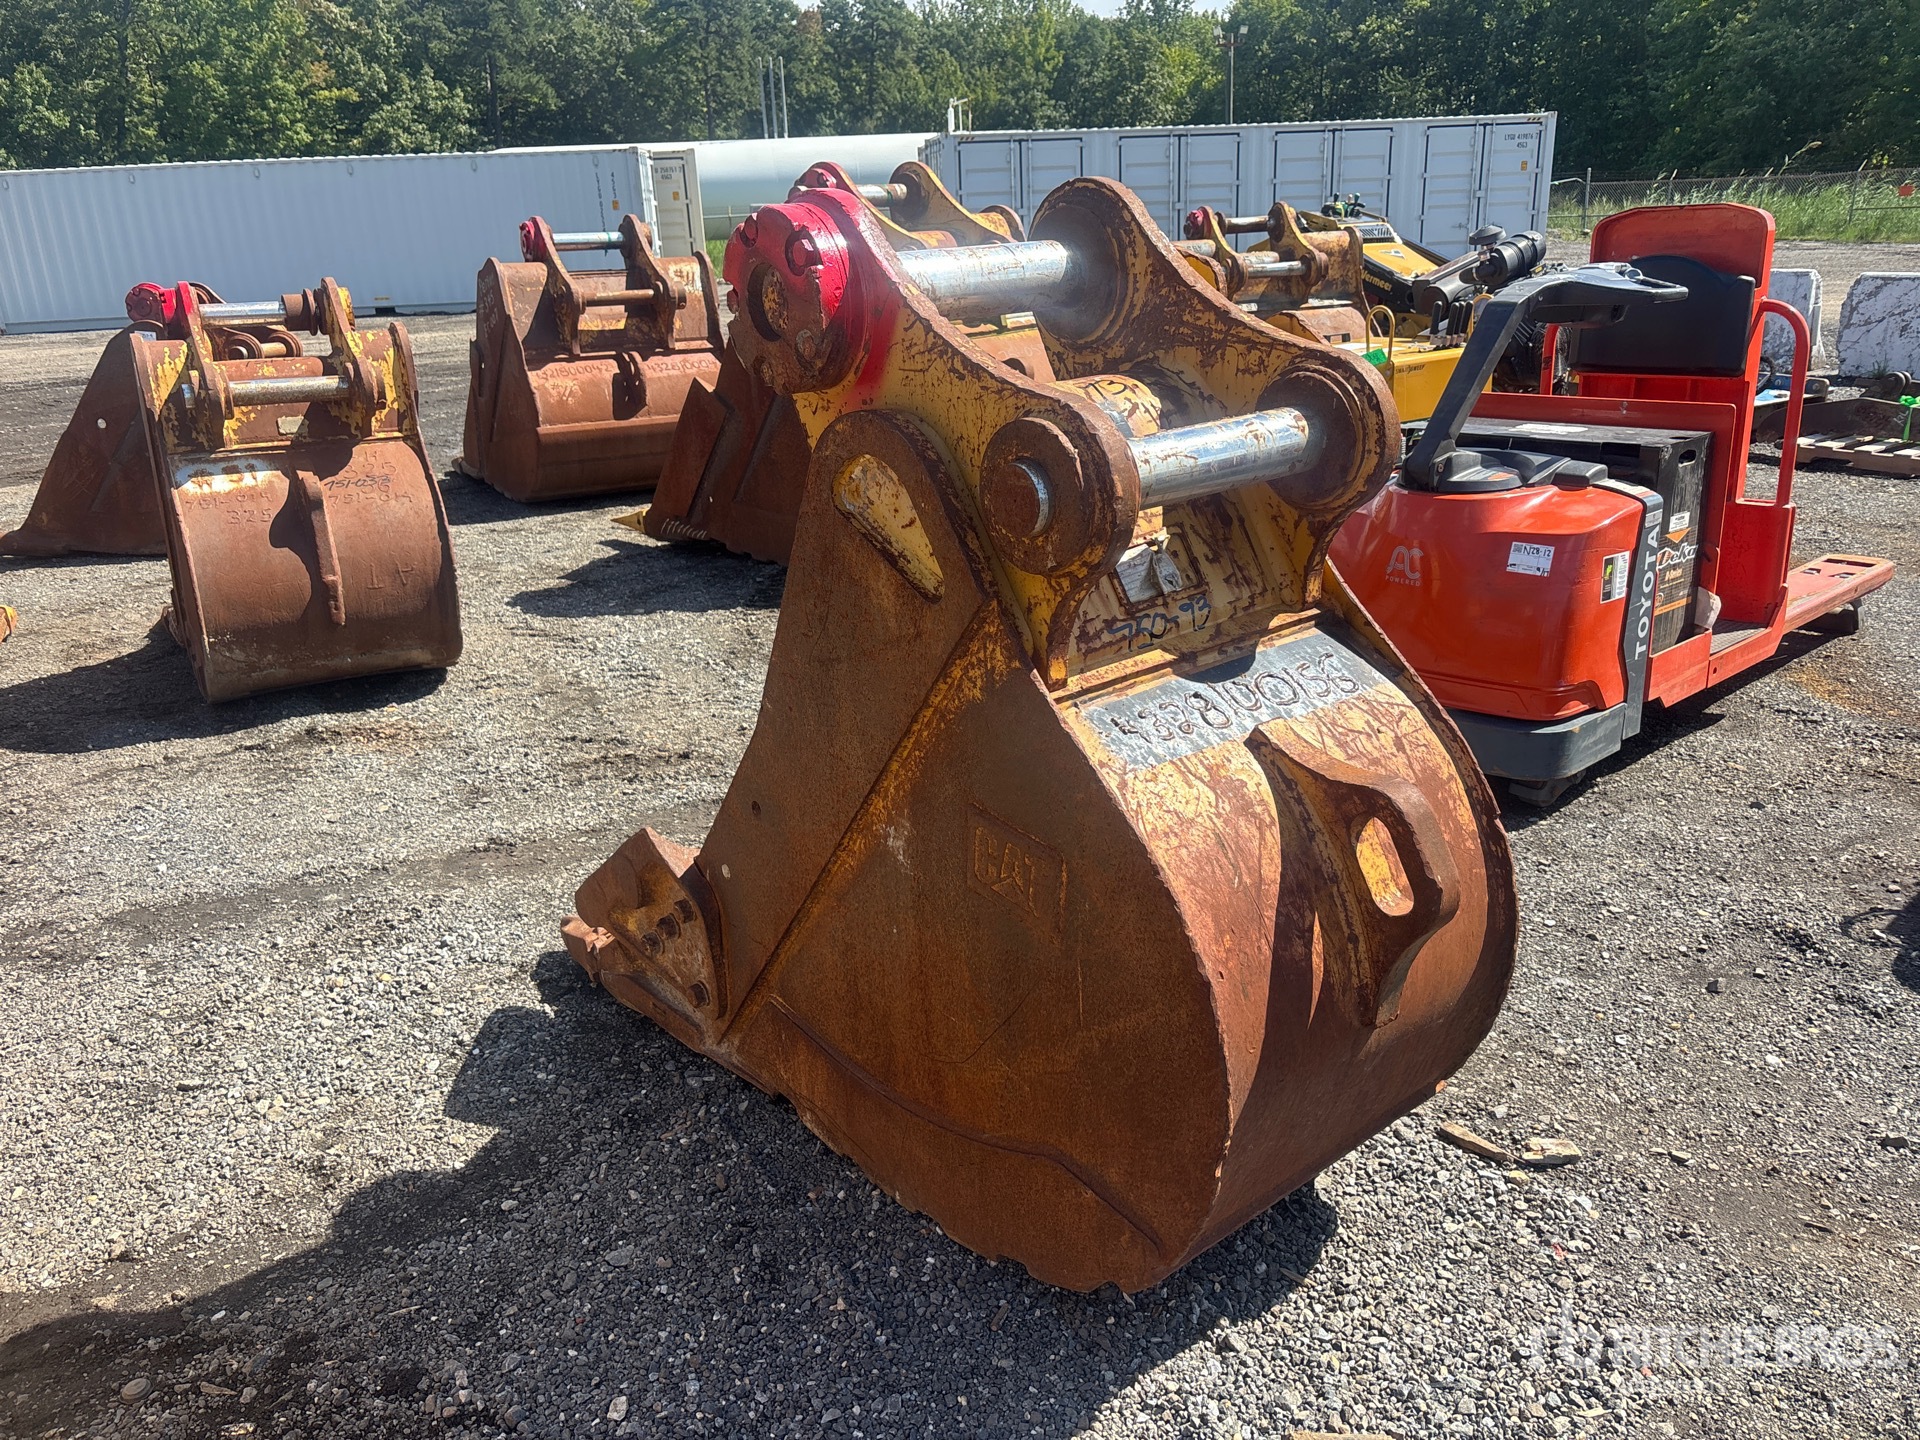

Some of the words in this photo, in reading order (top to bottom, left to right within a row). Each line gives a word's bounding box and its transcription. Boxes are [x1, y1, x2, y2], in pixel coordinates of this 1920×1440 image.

[1361, 270, 1392, 292] Vermeer
[1523, 545, 1552, 557] N28-12
[1657, 541, 1699, 569] Deka
[1385, 575, 1421, 587] POWERED
[1635, 524, 1660, 661] TOYOTA
[973, 826, 1043, 919] CAT
